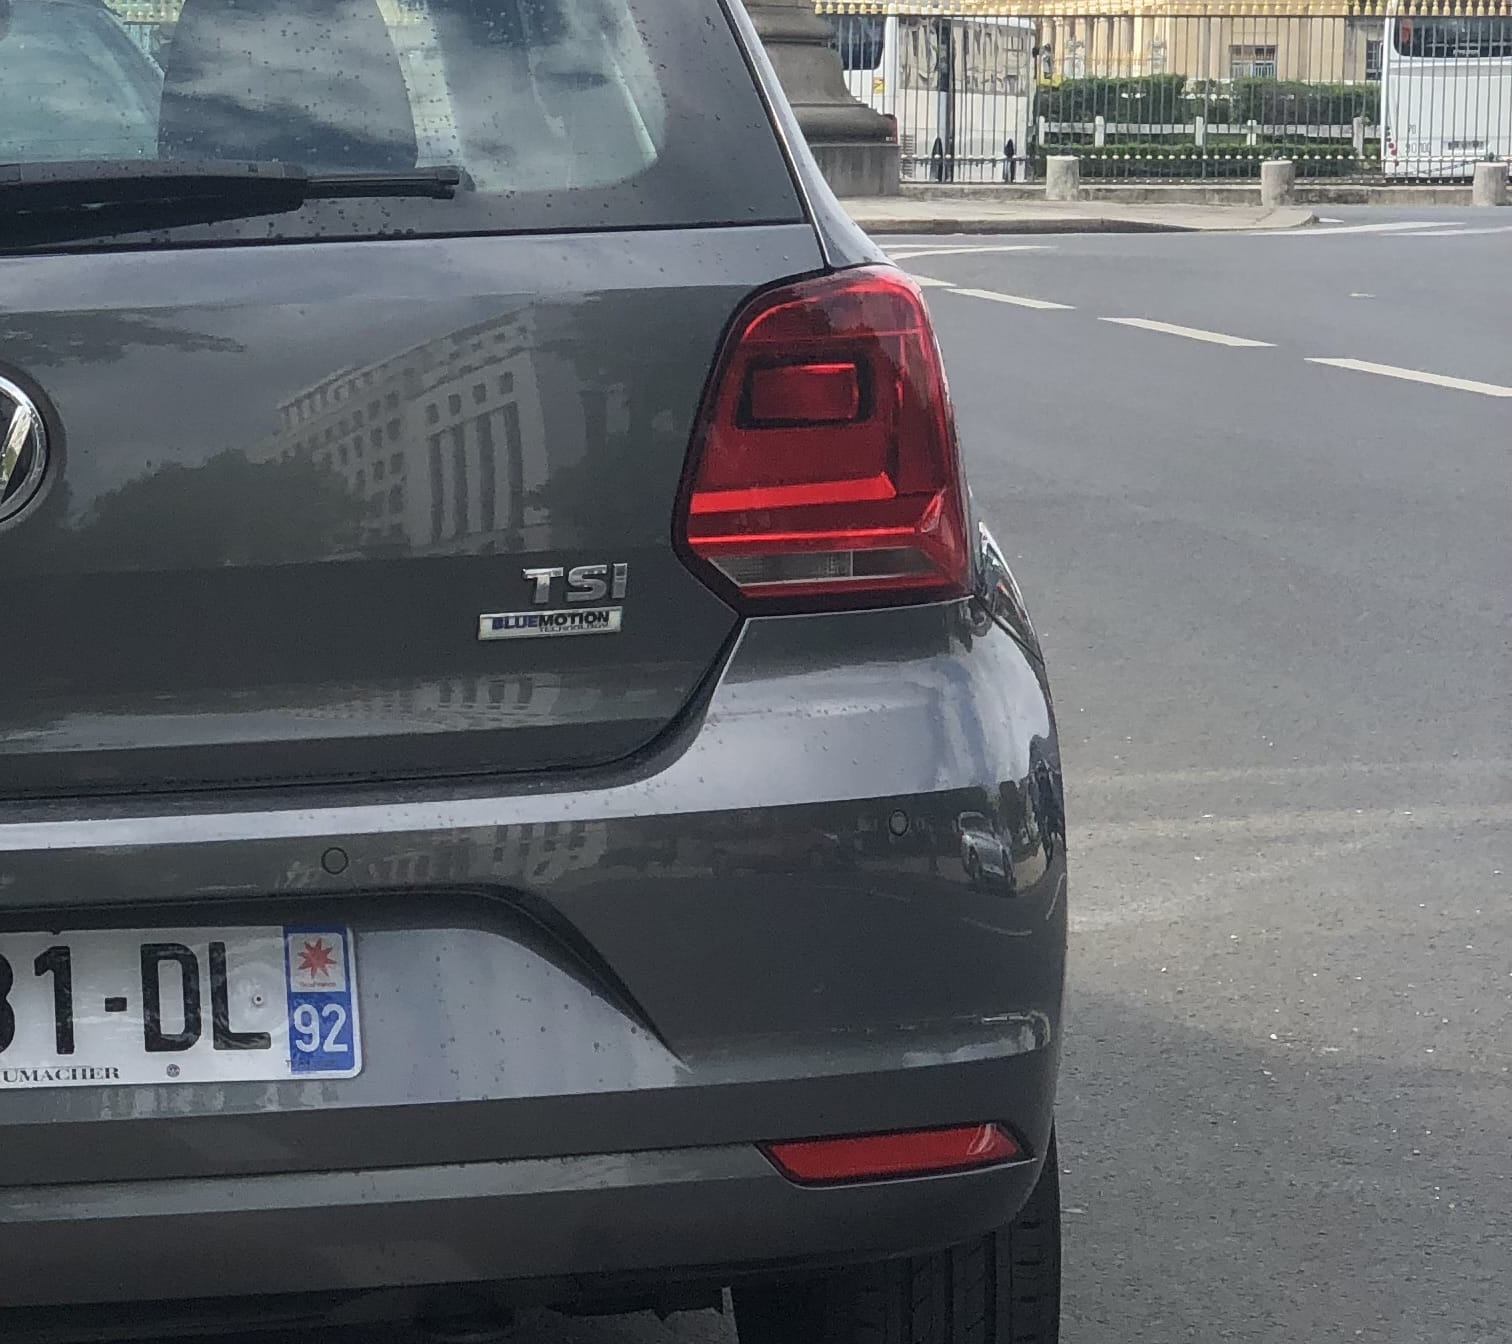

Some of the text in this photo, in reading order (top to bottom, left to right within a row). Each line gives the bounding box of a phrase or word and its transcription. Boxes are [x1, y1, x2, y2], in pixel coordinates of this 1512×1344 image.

[522, 562, 628, 604] TSI
[491, 611, 610, 630] BLUEMOTION
[293, 1003, 348, 1053] 92
